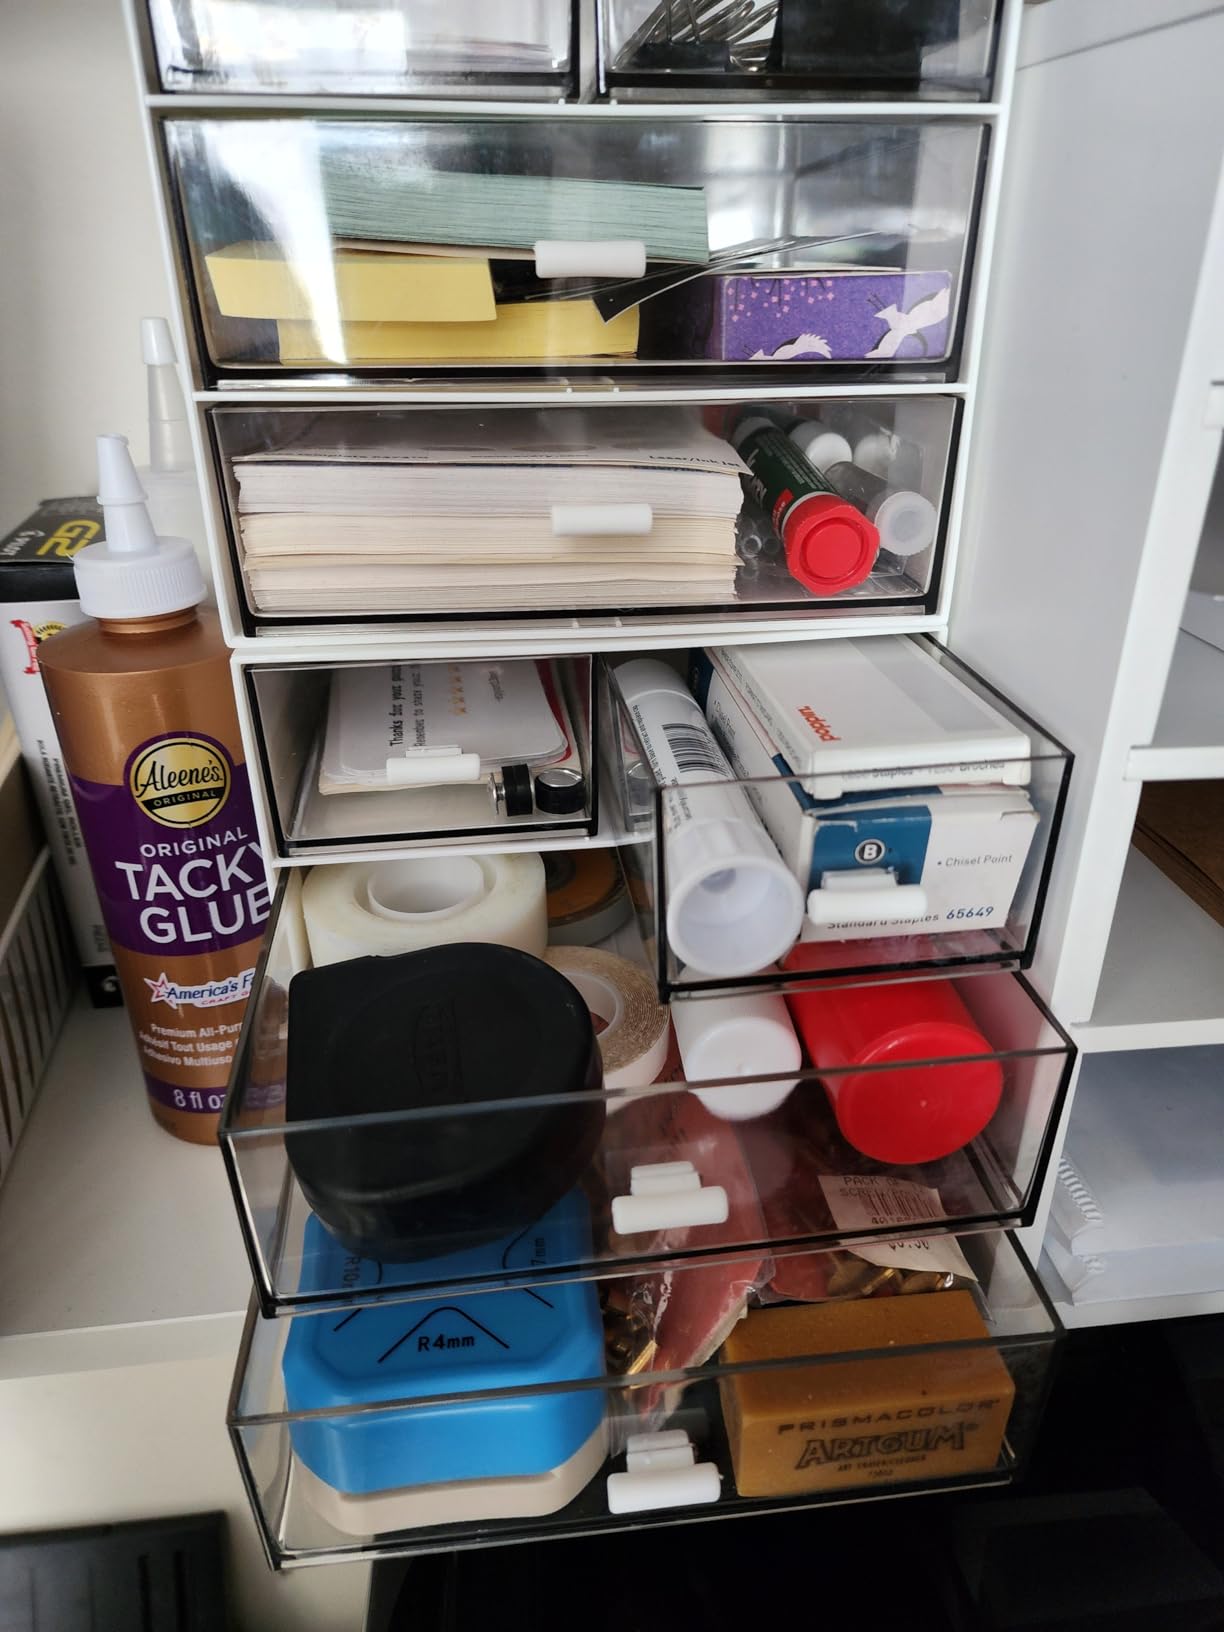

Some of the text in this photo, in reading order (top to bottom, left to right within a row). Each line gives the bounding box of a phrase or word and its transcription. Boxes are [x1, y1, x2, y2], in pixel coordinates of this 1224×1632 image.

[36, 519, 101, 557] G2
[388, 704, 403, 716] for
[798, 705, 842, 742] poppin
[388, 720, 404, 747] Thanks
[136, 760, 223, 798] Aleene's
[152, 789, 217, 808] ORIGINAL
[140, 826, 248, 858] ORIGINAL
[114, 842, 267, 902] TACKY
[944, 854, 1013, 867] Chisel Point
[139, 880, 271, 944] GLUE
[946, 906, 995, 921] 65649
[165, 980, 239, 1001] America's
[150, 1023, 197, 1038] Premium
[196, 1041, 233, 1052] Usage
[173, 1088, 187, 1107] 8
[189, 1091, 202, 1109] fl
[777, 1400, 994, 1434] PRISMACOLOR
[795, 1421, 966, 1470] ARTGUM
